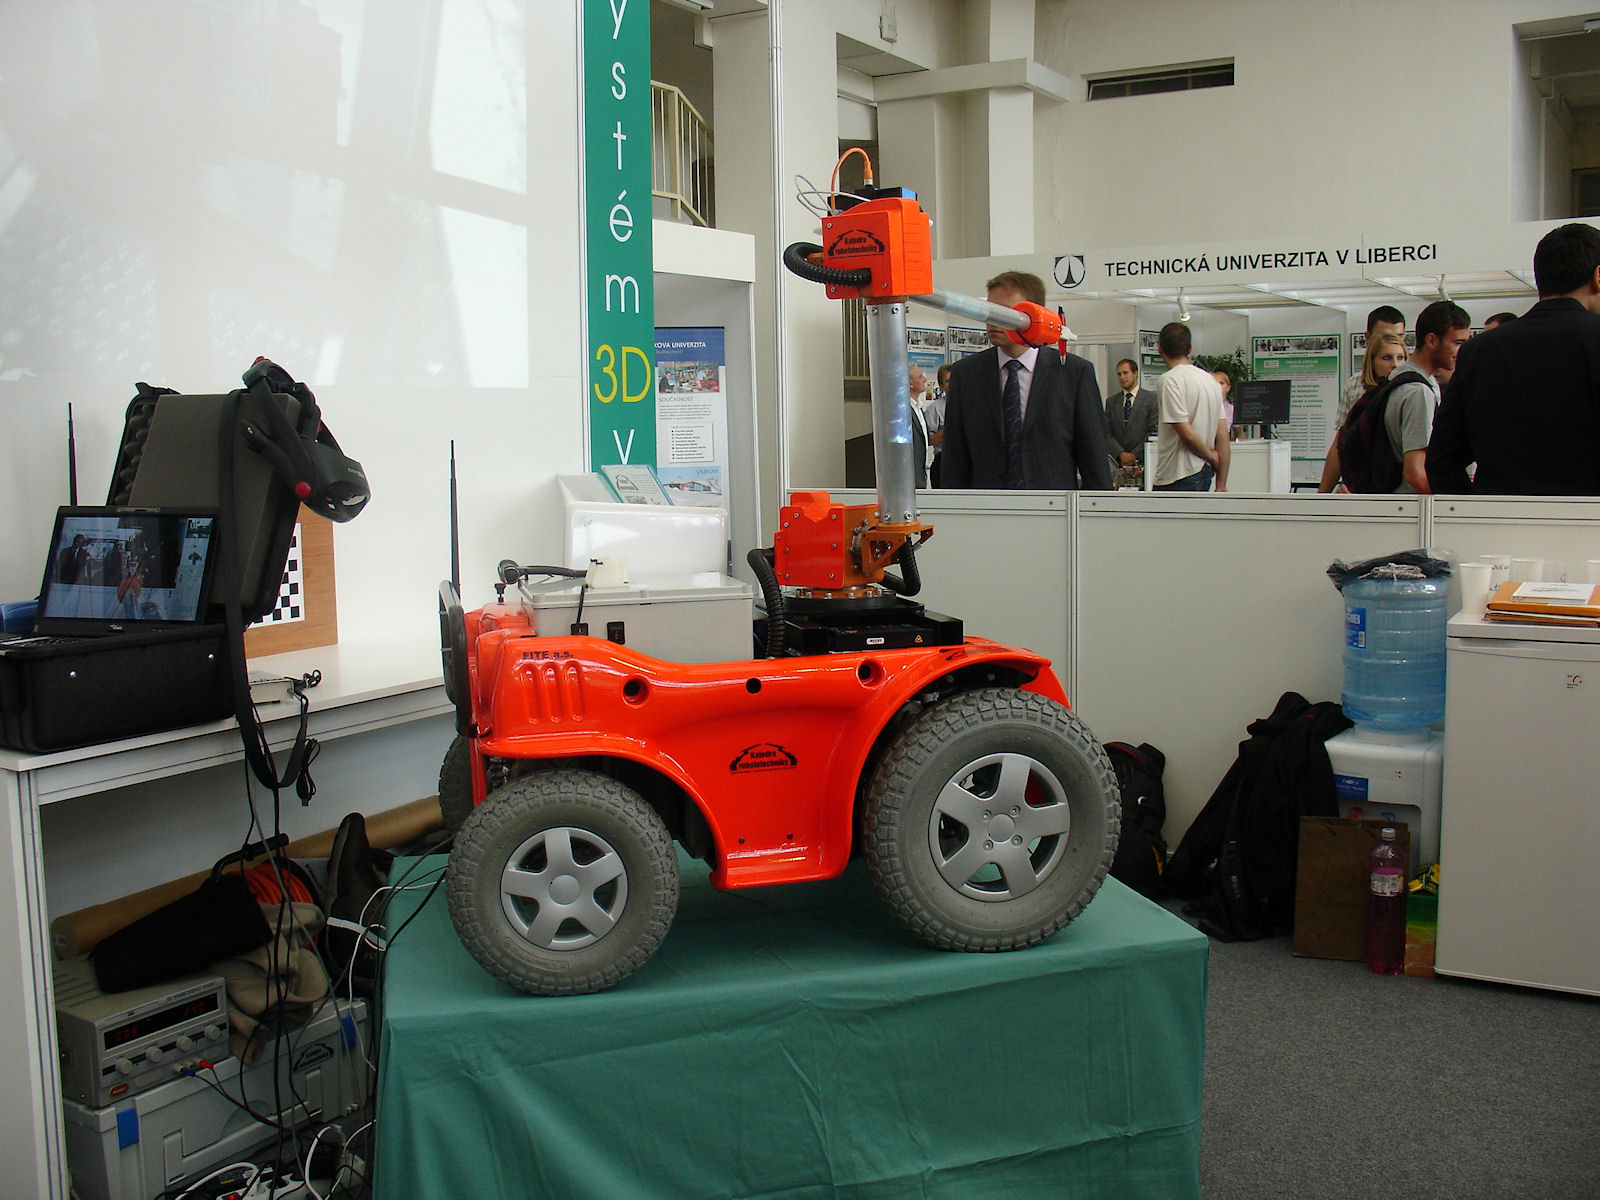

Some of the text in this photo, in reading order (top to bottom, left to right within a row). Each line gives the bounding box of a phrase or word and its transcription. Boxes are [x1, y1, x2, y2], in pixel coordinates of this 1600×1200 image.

[1104, 244, 1437, 277] TECHNICKÁ UNIVERZITA V LIBERCI
[671, 341, 707, 349] UNIVERZITA
[594, 344, 651, 404] 3D
[612, 428, 635, 465] v
[522, 650, 550, 660] FITE
[750, 750, 777, 758] Katedra
[738, 759, 789, 769] robototechniky
